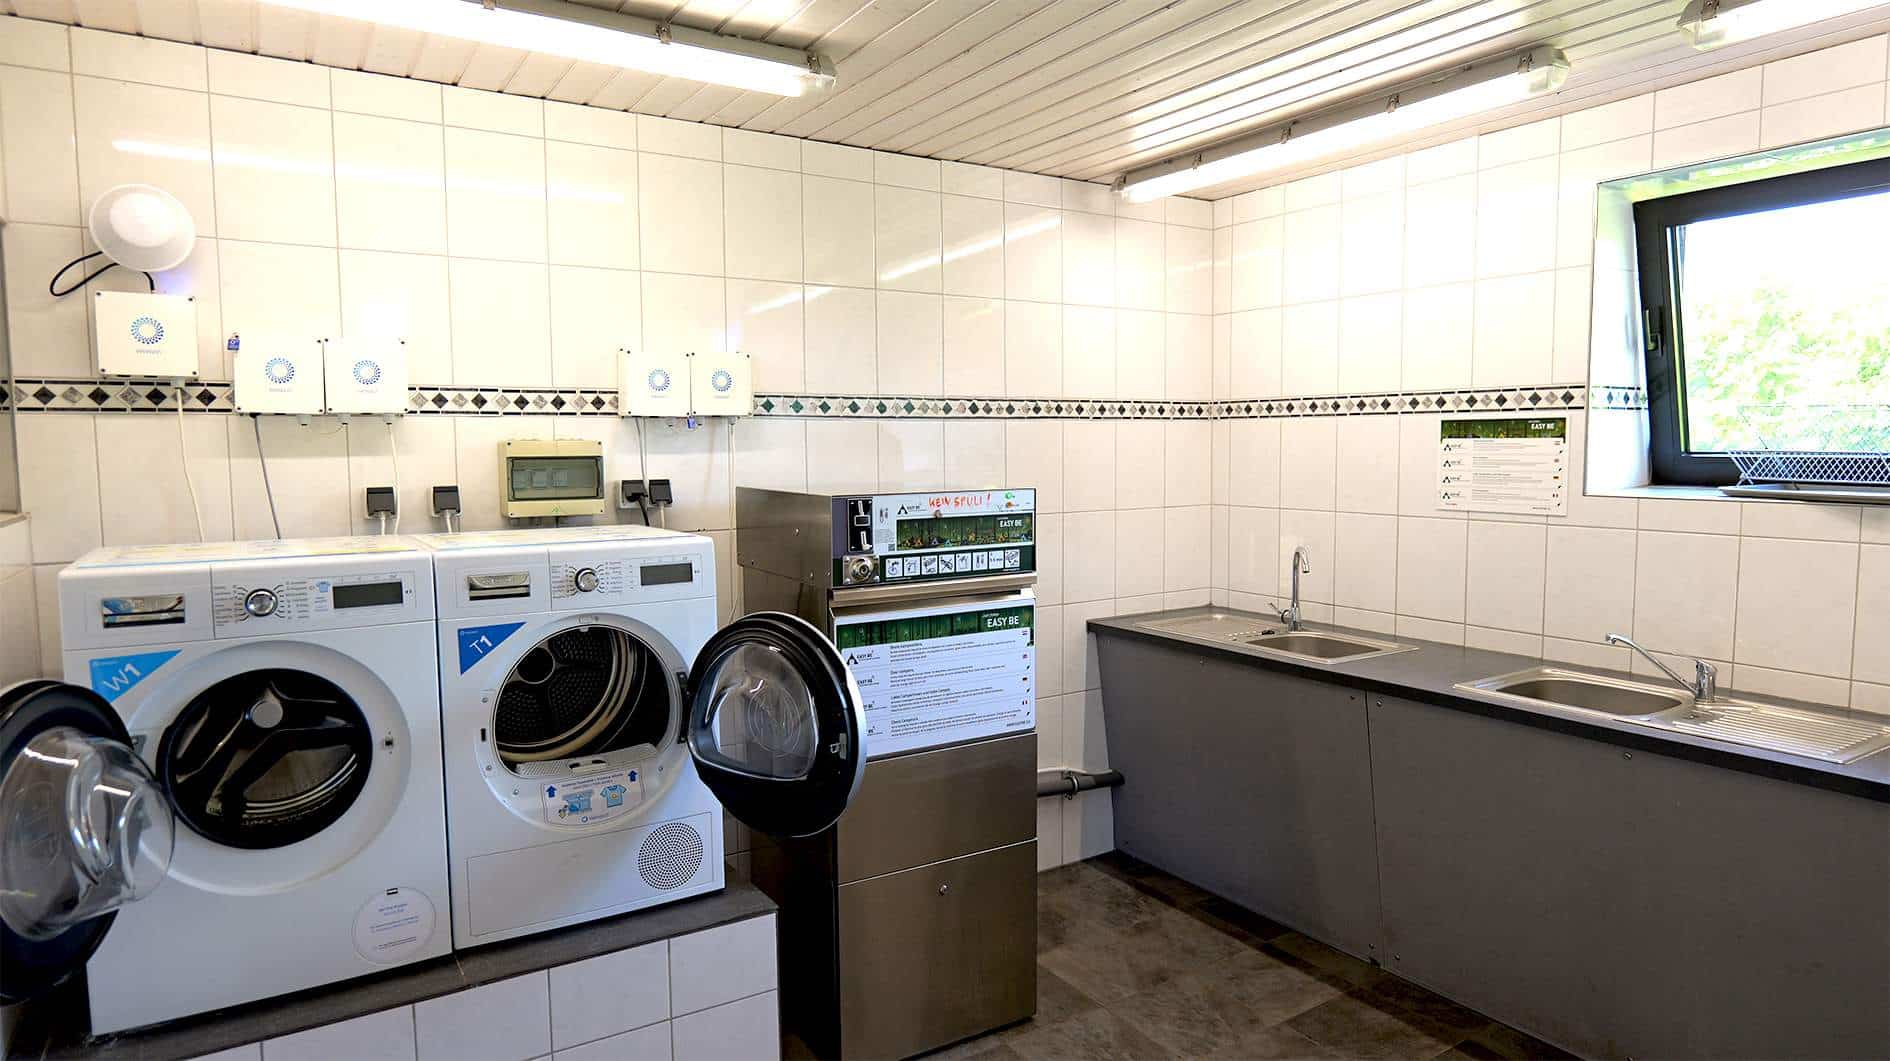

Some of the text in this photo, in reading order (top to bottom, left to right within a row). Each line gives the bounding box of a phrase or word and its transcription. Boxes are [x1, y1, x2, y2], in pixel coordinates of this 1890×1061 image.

[987, 617, 1007, 628] EASY
[1008, 615, 1019, 625] BE
[469, 635, 493, 654] T1
[103, 663, 141, 692] W1
